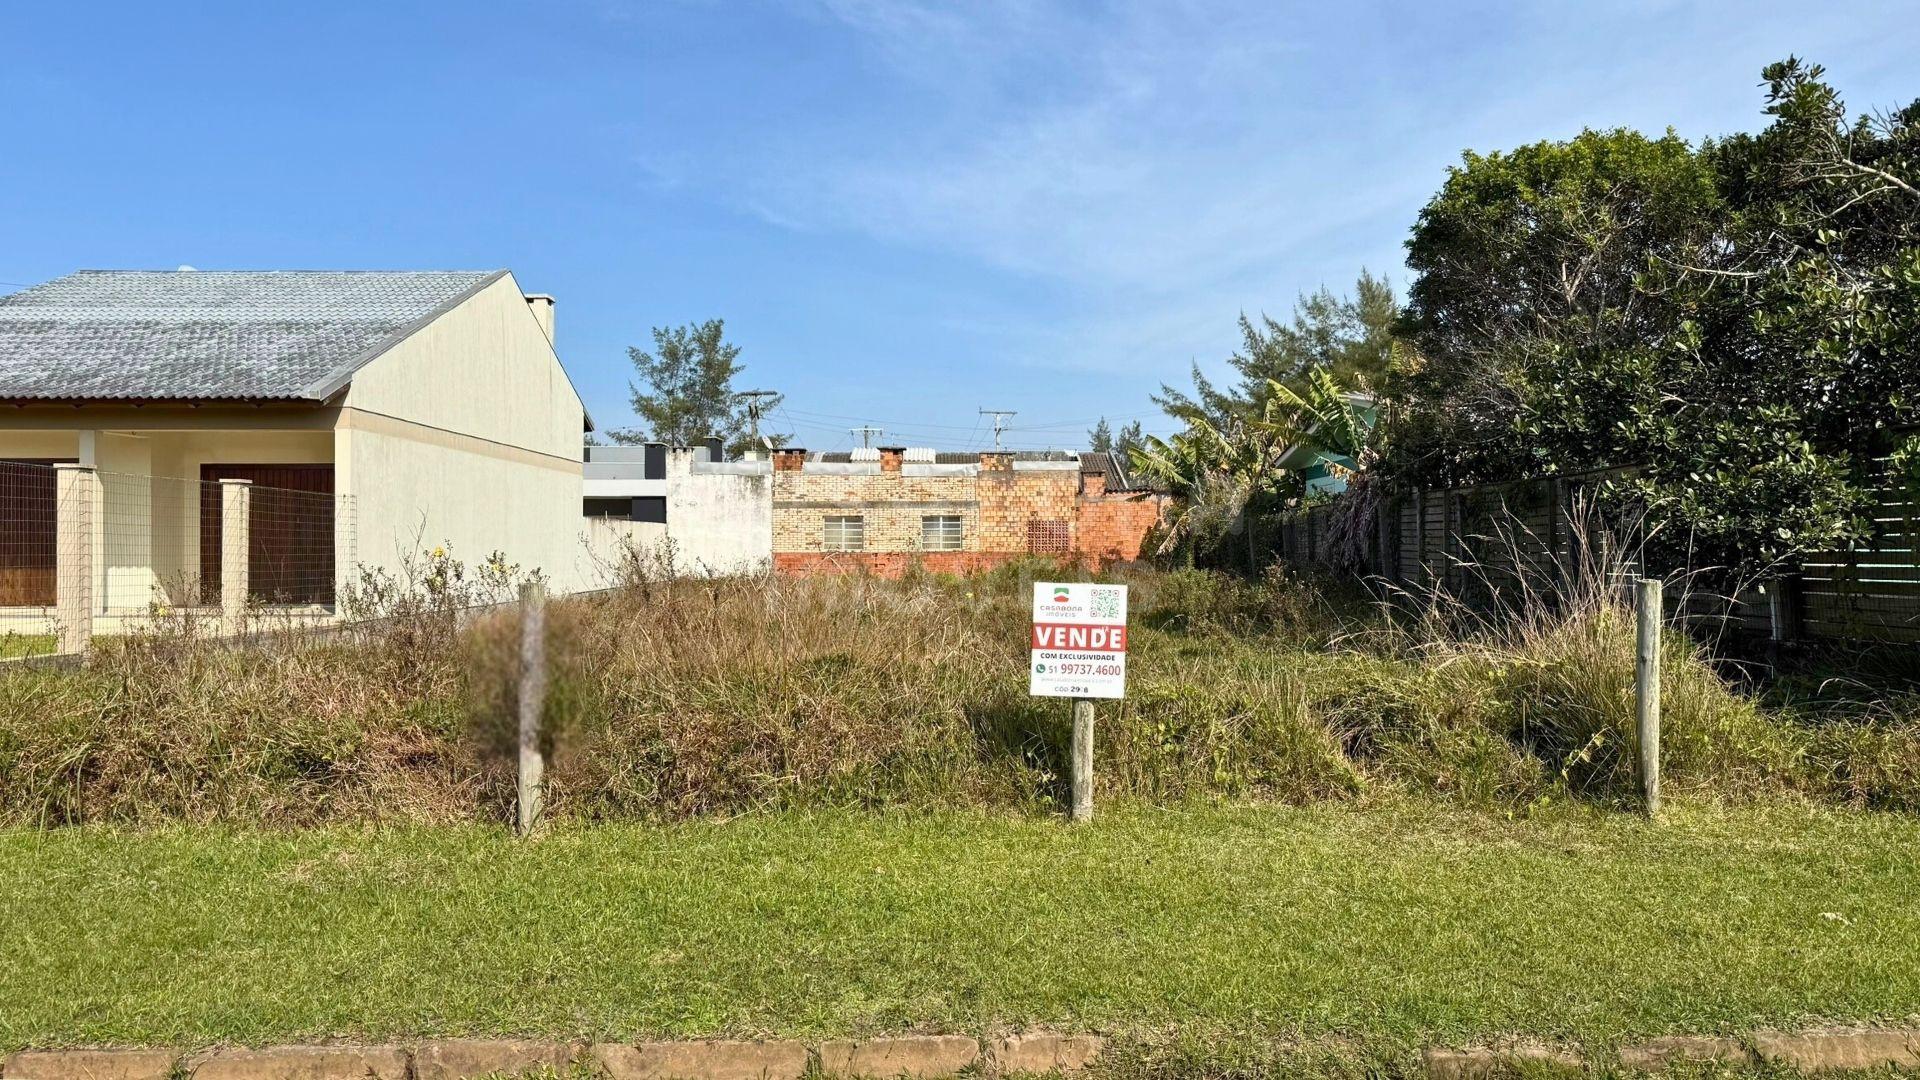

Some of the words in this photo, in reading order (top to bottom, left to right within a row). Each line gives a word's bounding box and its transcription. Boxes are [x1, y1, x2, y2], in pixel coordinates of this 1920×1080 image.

[1035, 626, 1122, 649] VENDE
[1059, 653, 1116, 661] EXCLUSIVIDADE
[1048, 665, 1058, 674] 51
[1060, 664, 1121, 676] 99737.4600
